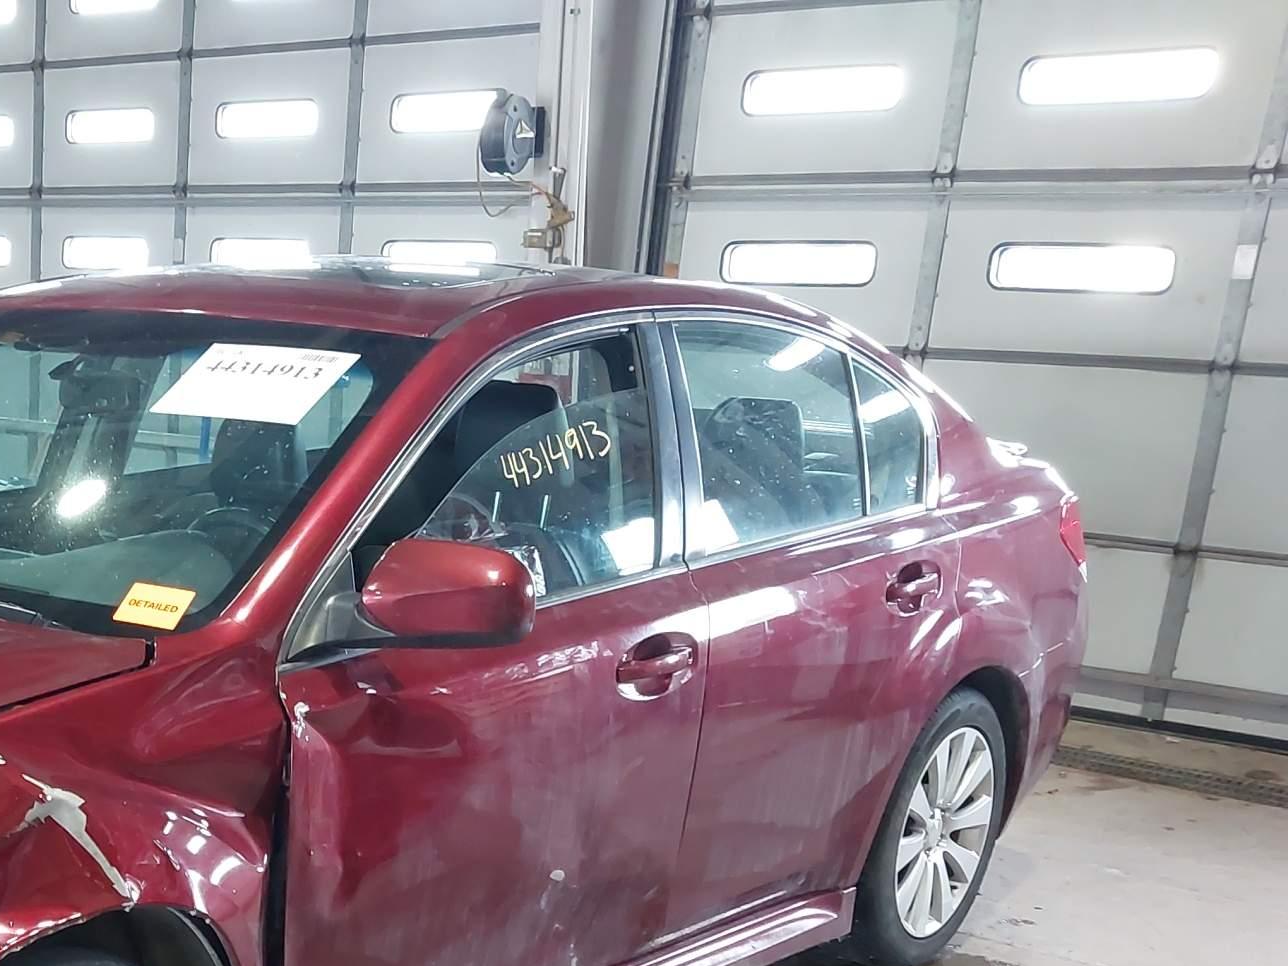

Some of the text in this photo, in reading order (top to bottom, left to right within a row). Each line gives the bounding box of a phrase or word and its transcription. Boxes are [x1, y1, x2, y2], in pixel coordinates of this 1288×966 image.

[205, 360, 324, 380] 44314913
[500, 420, 612, 488] 44314913
[128, 598, 179, 613] DETAILED
